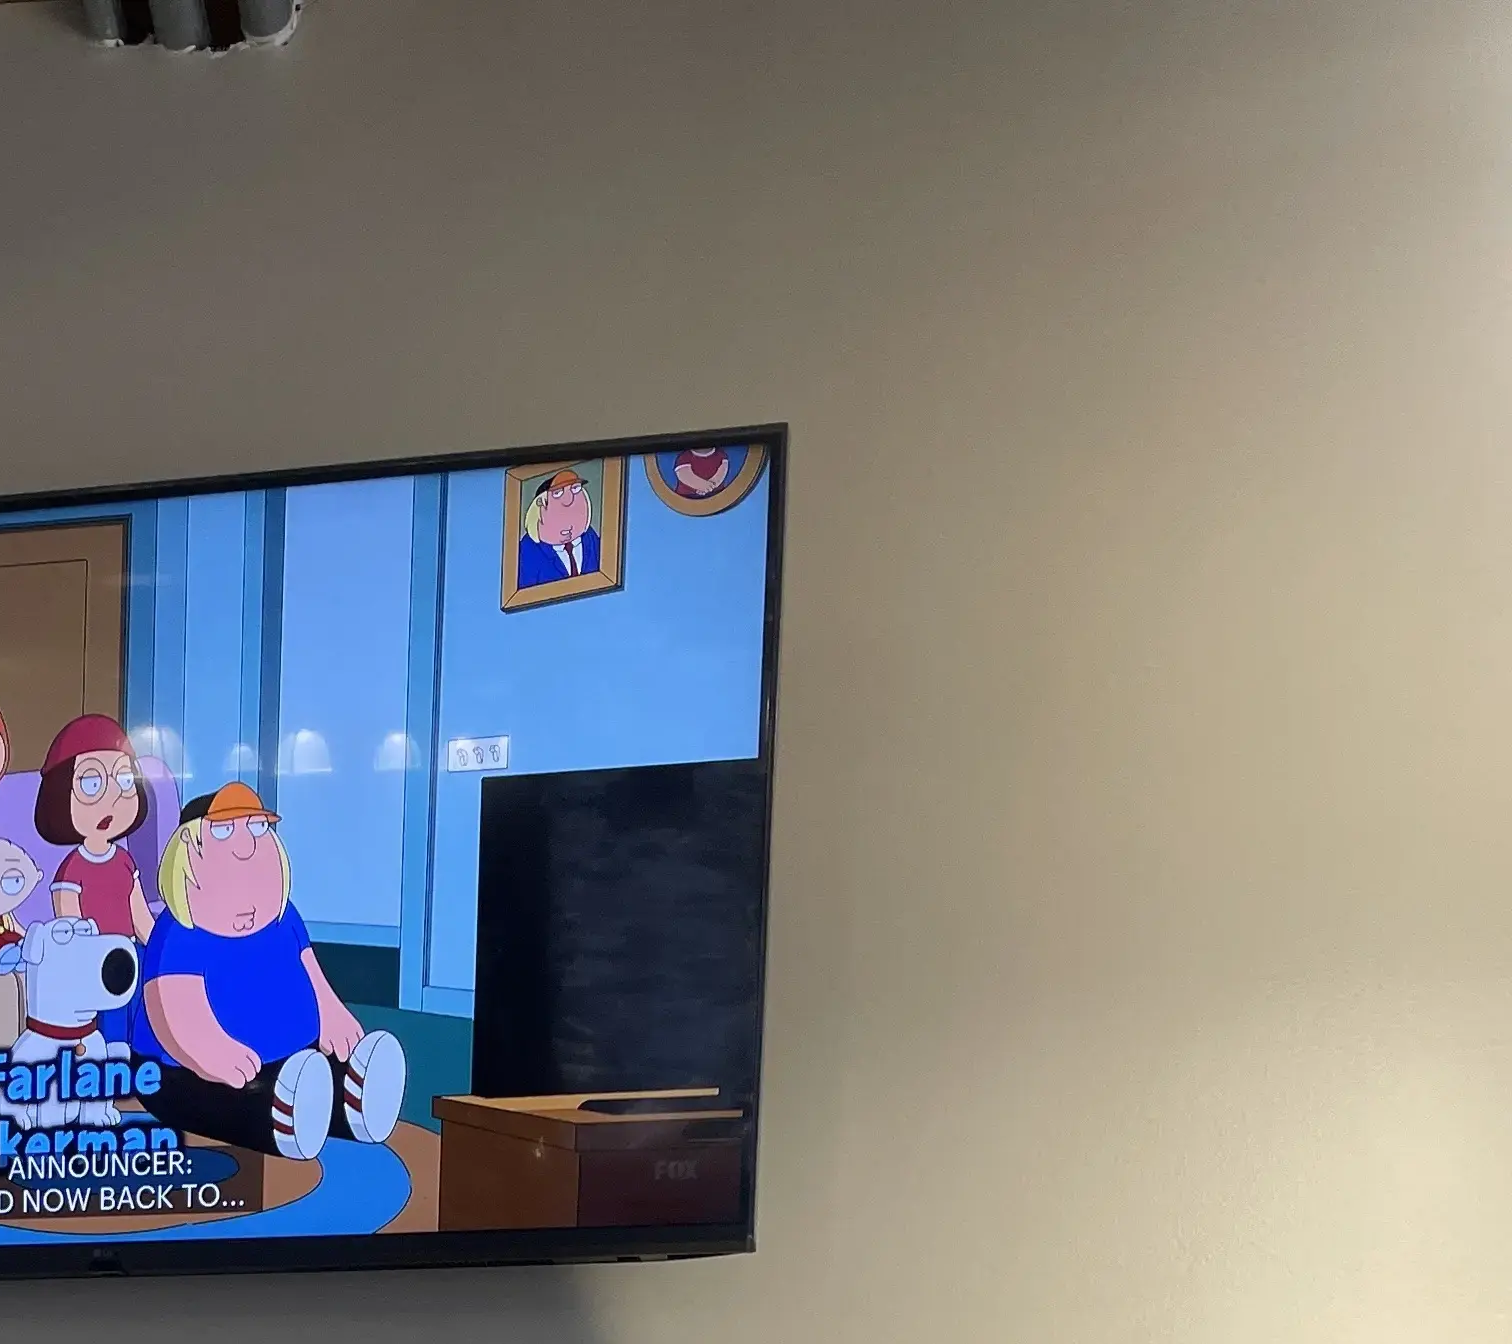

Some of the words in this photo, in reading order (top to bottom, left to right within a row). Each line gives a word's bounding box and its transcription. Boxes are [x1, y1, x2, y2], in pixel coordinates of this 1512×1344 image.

[8, 1152, 192, 1181] ANNOUNCER:
[22, 1190, 89, 1213] NOW
[99, 1185, 173, 1211] BACK
[182, 1184, 245, 1208] TO...
